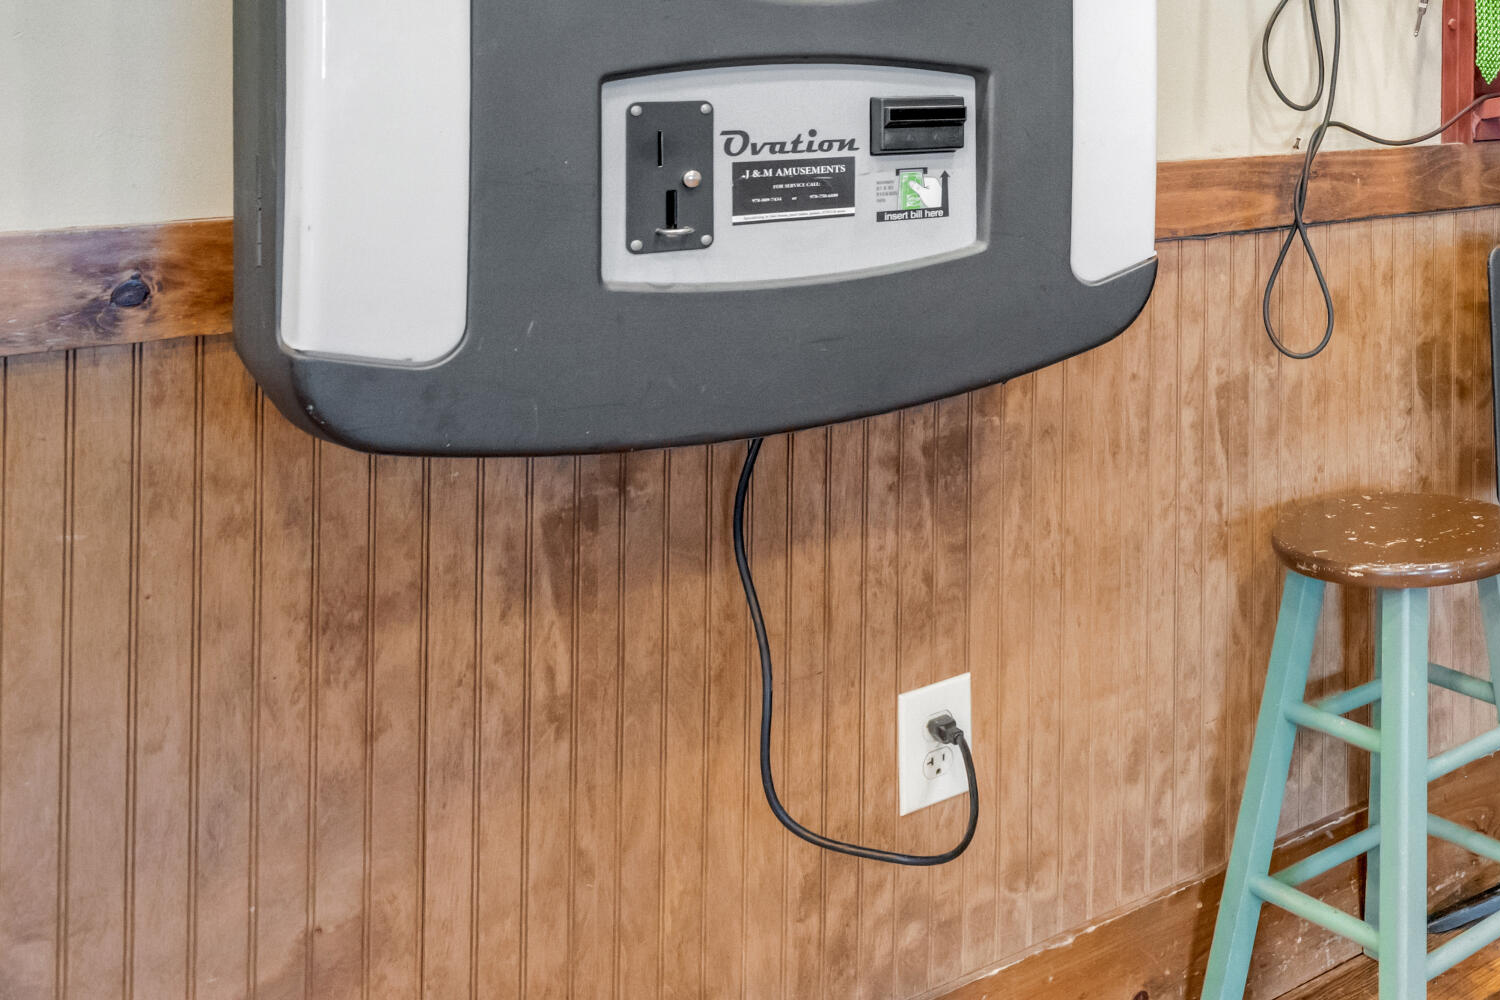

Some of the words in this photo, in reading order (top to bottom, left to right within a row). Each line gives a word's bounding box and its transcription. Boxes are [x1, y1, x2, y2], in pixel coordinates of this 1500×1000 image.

[720, 129, 860, 157] Ovation
[762, 168, 773, 177] M
[775, 164, 846, 177] AMUSEMENTS
[884, 211, 908, 220] insert
[911, 210, 923, 219] bill
[925, 209, 943, 218] here
